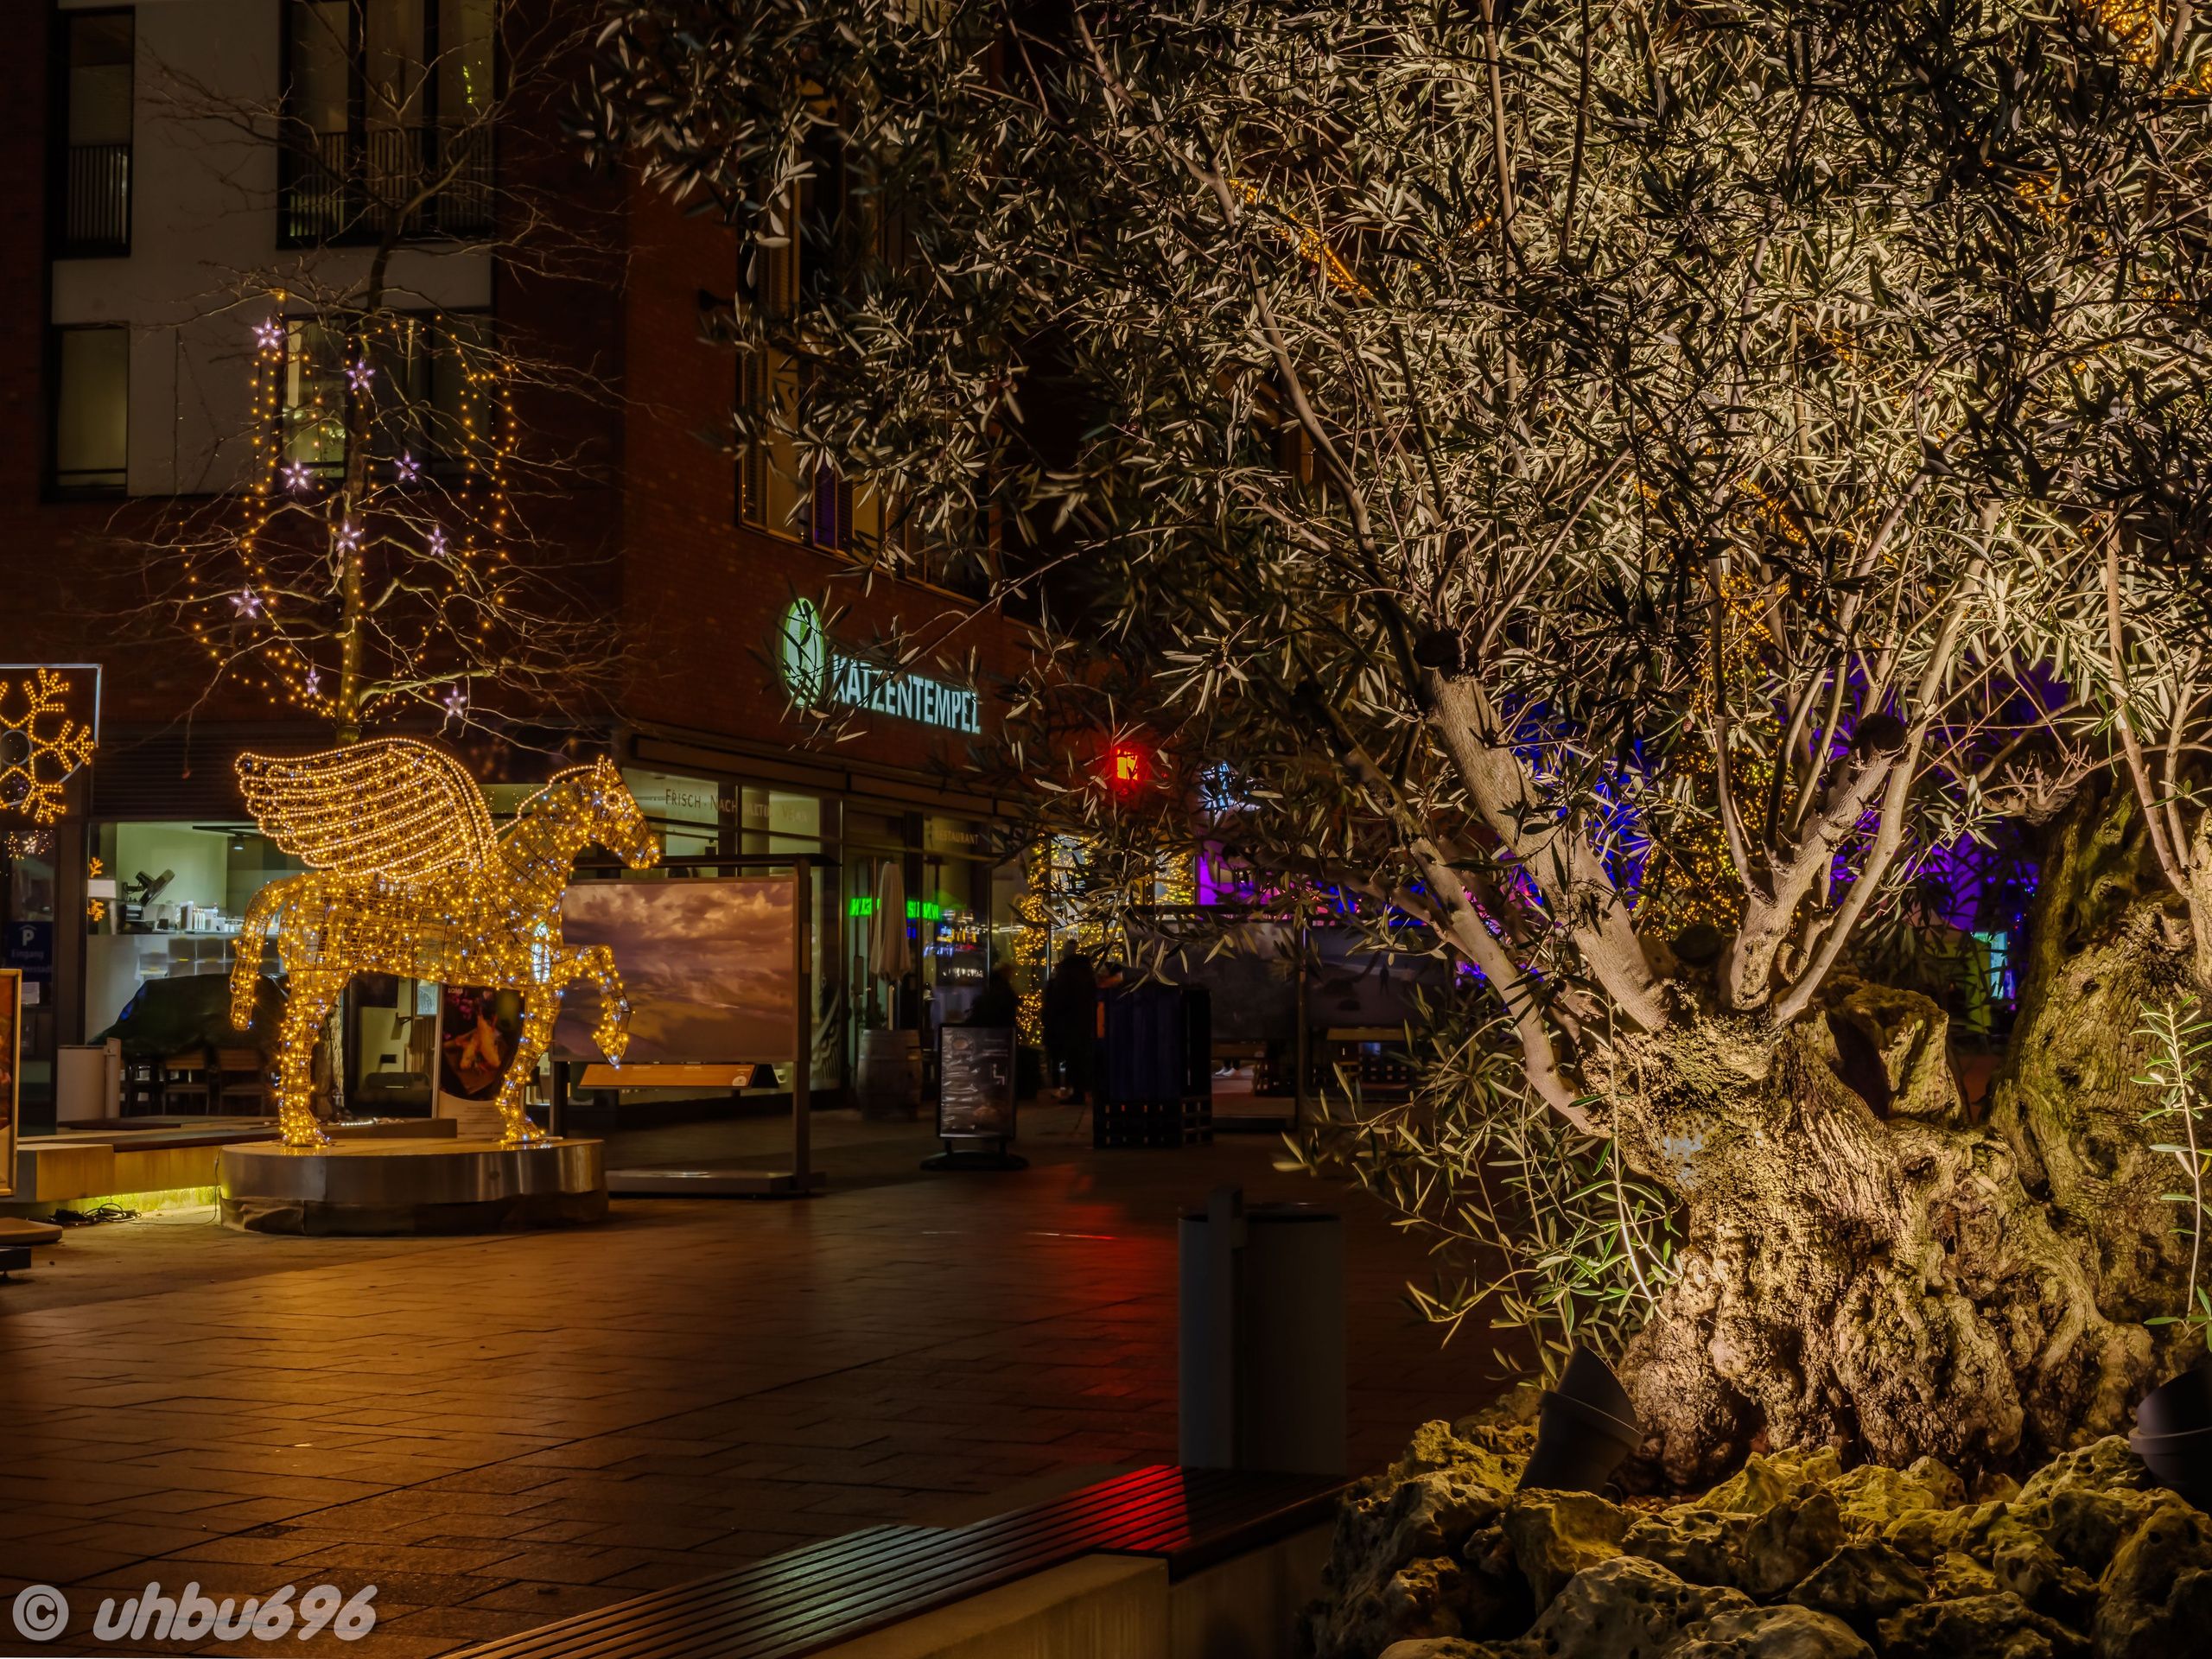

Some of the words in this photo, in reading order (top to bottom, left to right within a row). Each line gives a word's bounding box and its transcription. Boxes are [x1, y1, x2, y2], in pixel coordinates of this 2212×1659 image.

[831, 653, 981, 734] KATZENTEMPEL
[664, 788, 702, 809] FRISCH
[22, 929, 35, 947] P
[11, 949, 45, 961] Eingang
